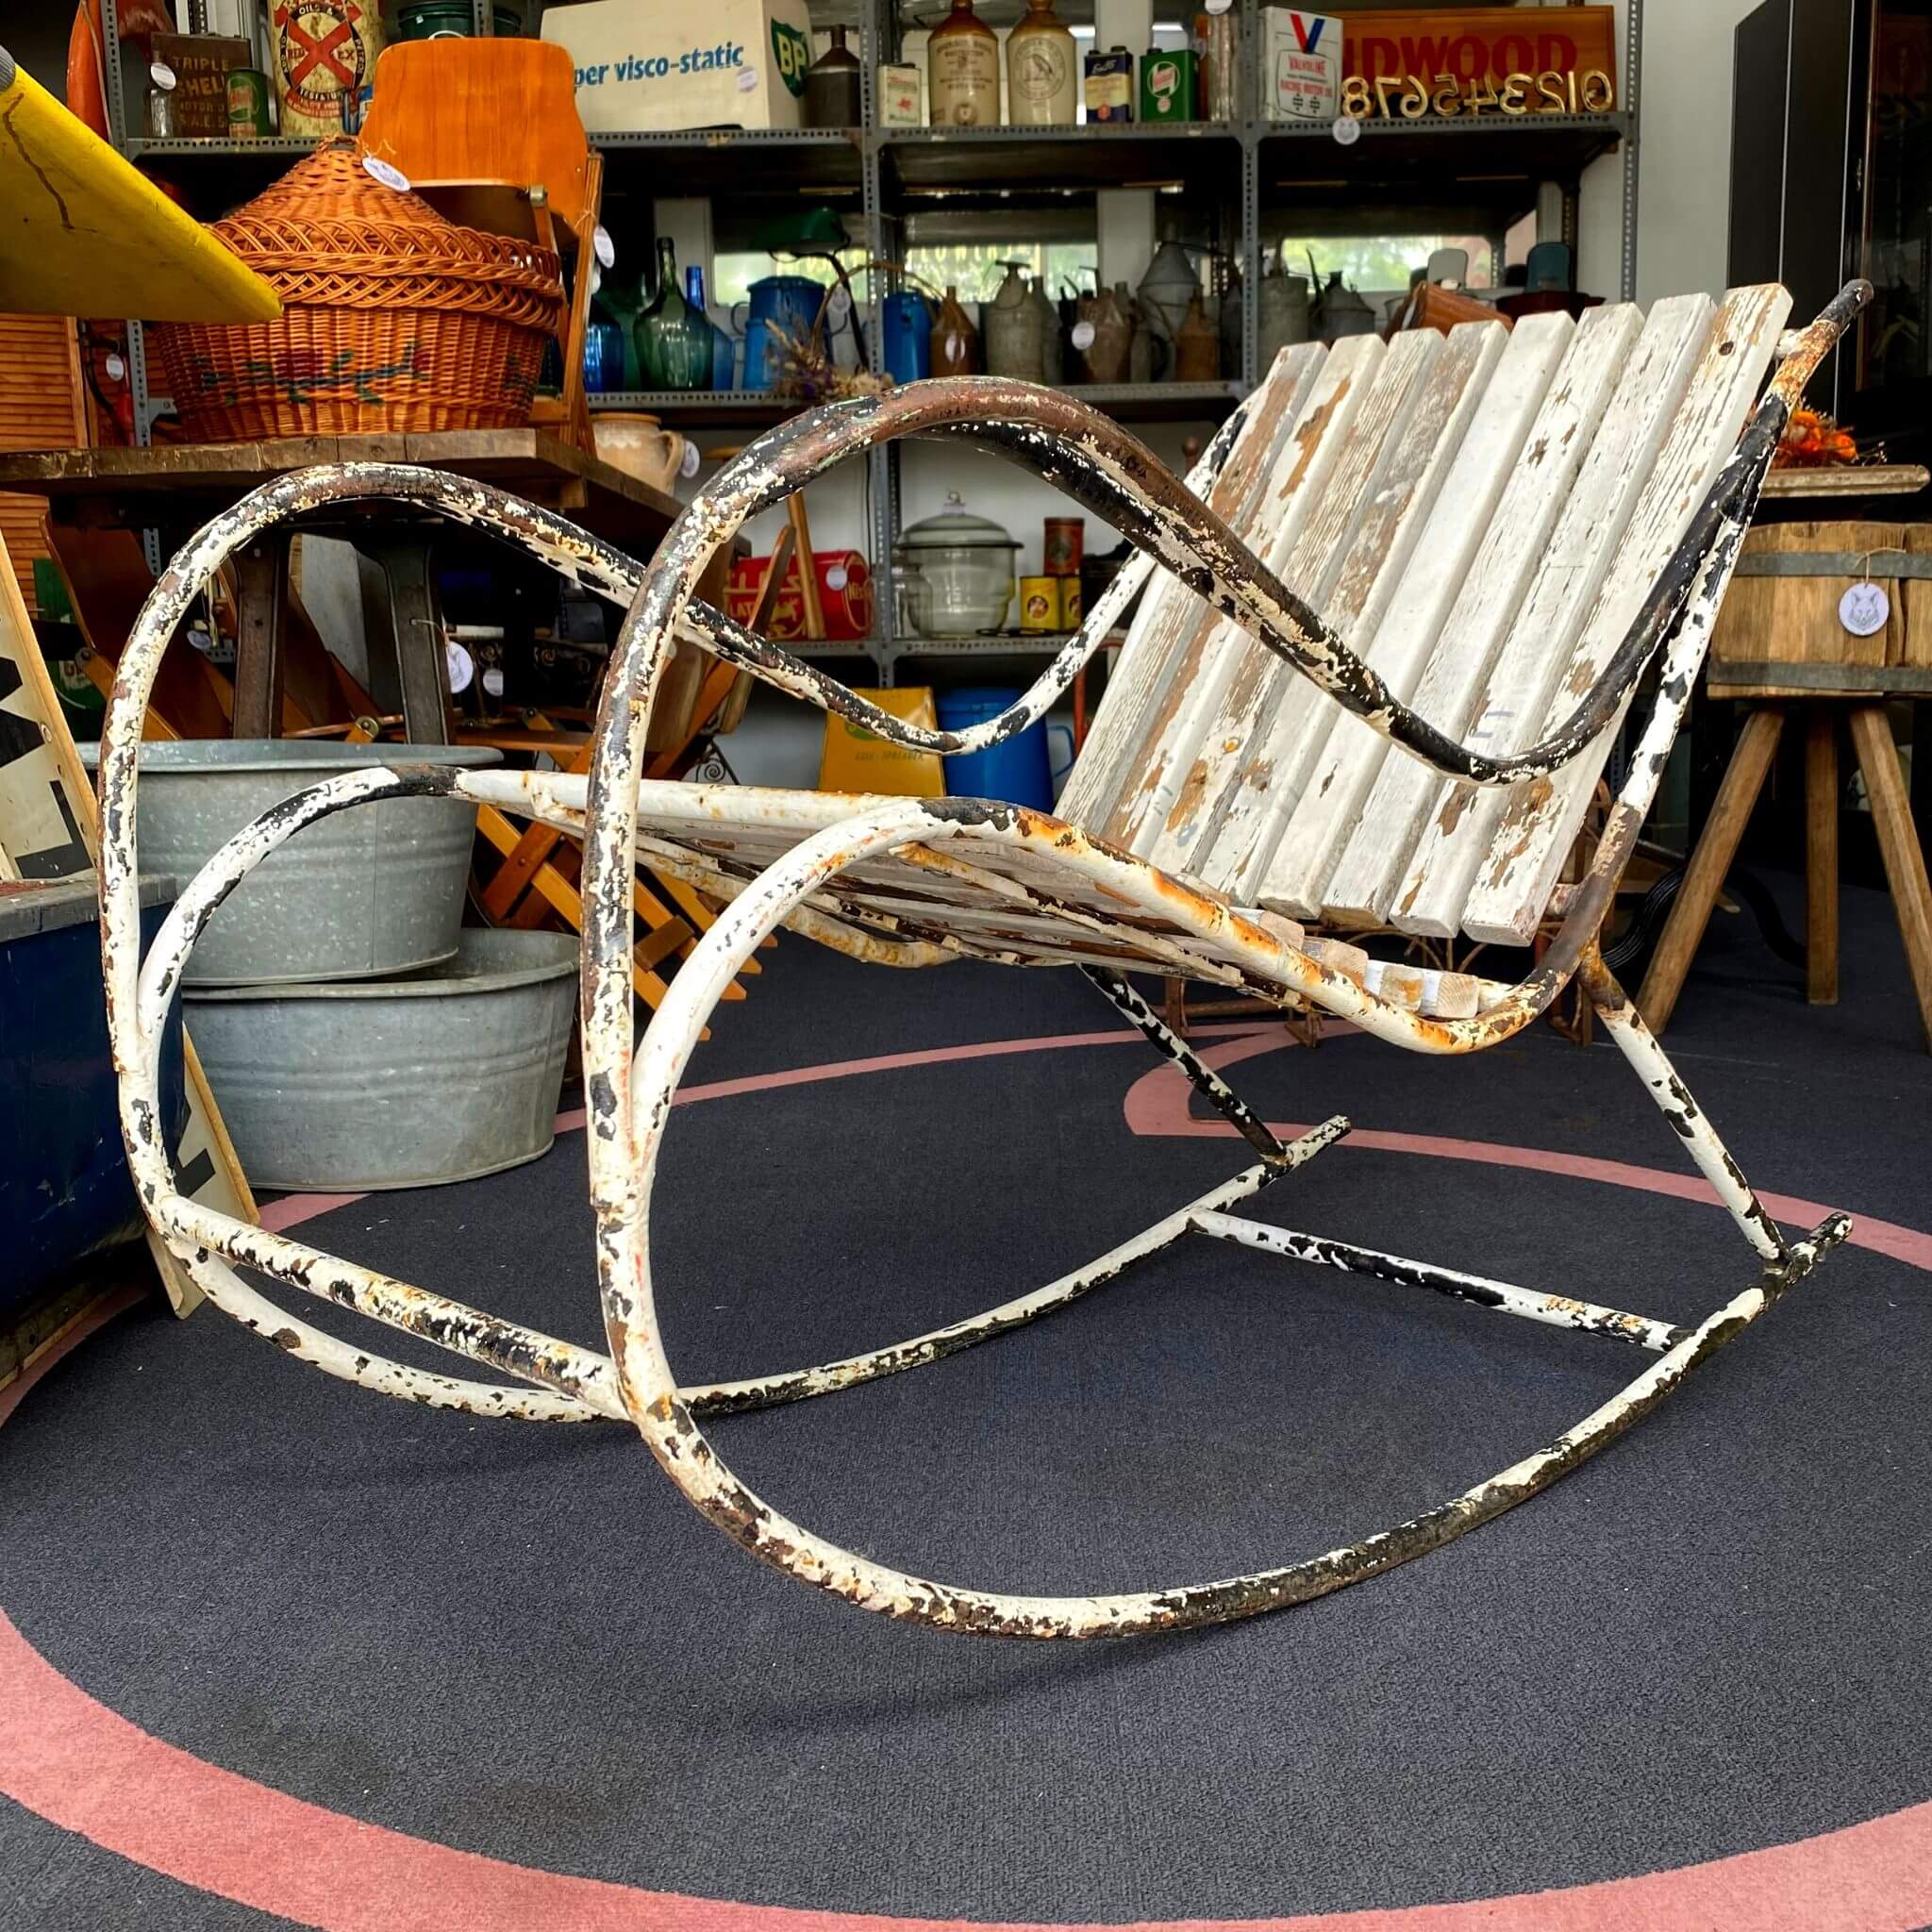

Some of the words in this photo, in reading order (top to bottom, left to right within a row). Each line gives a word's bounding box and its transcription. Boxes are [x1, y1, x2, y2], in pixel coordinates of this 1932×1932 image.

[173, 56, 229, 72] TRIPLE
[615, 41, 744, 82] visco-static
[777, 32, 807, 81] BP
